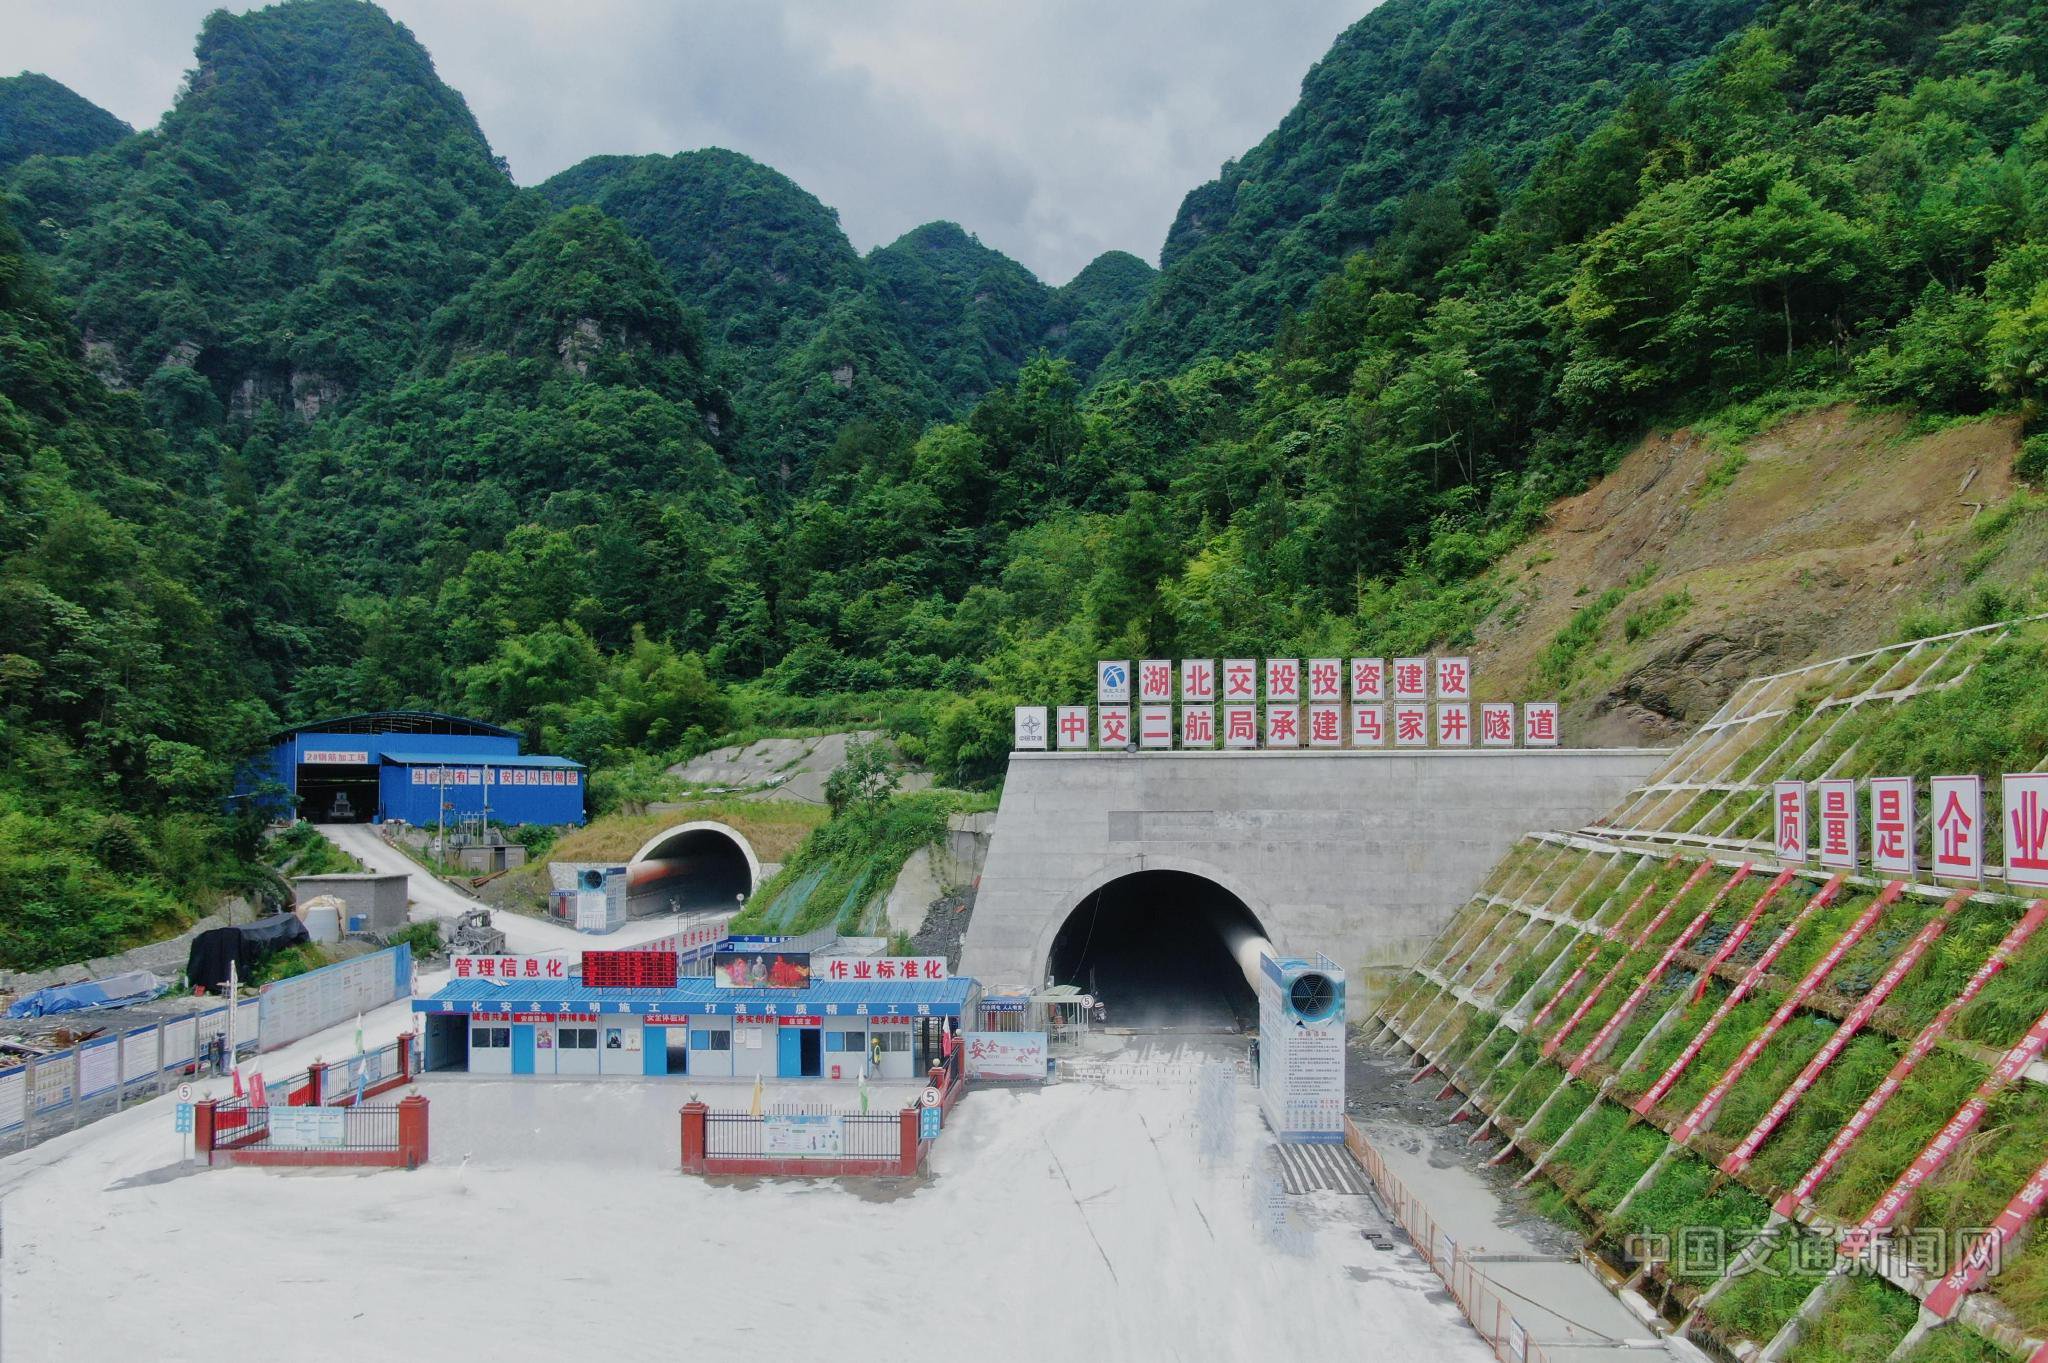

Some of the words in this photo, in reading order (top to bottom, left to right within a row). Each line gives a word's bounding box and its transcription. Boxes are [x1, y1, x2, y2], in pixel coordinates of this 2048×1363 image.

[1143, 664, 1467, 693] 湖北交投投资建设
[1061, 711, 1557, 742] 中交二航局承建马家井隧道
[502, 771, 577, 784] 安全从我做起
[1778, 789, 2048, 868] 质量是企业
[455, 958, 563, 977] 管理信息化
[830, 960, 942, 979] 作业标准化
[442, 1002, 660, 1013] 强化安全文明施工
[705, 1002, 931, 1015] 打造优质精品工程
[182, 1086, 189, 1098] 5
[926, 1091, 935, 1103] 5
